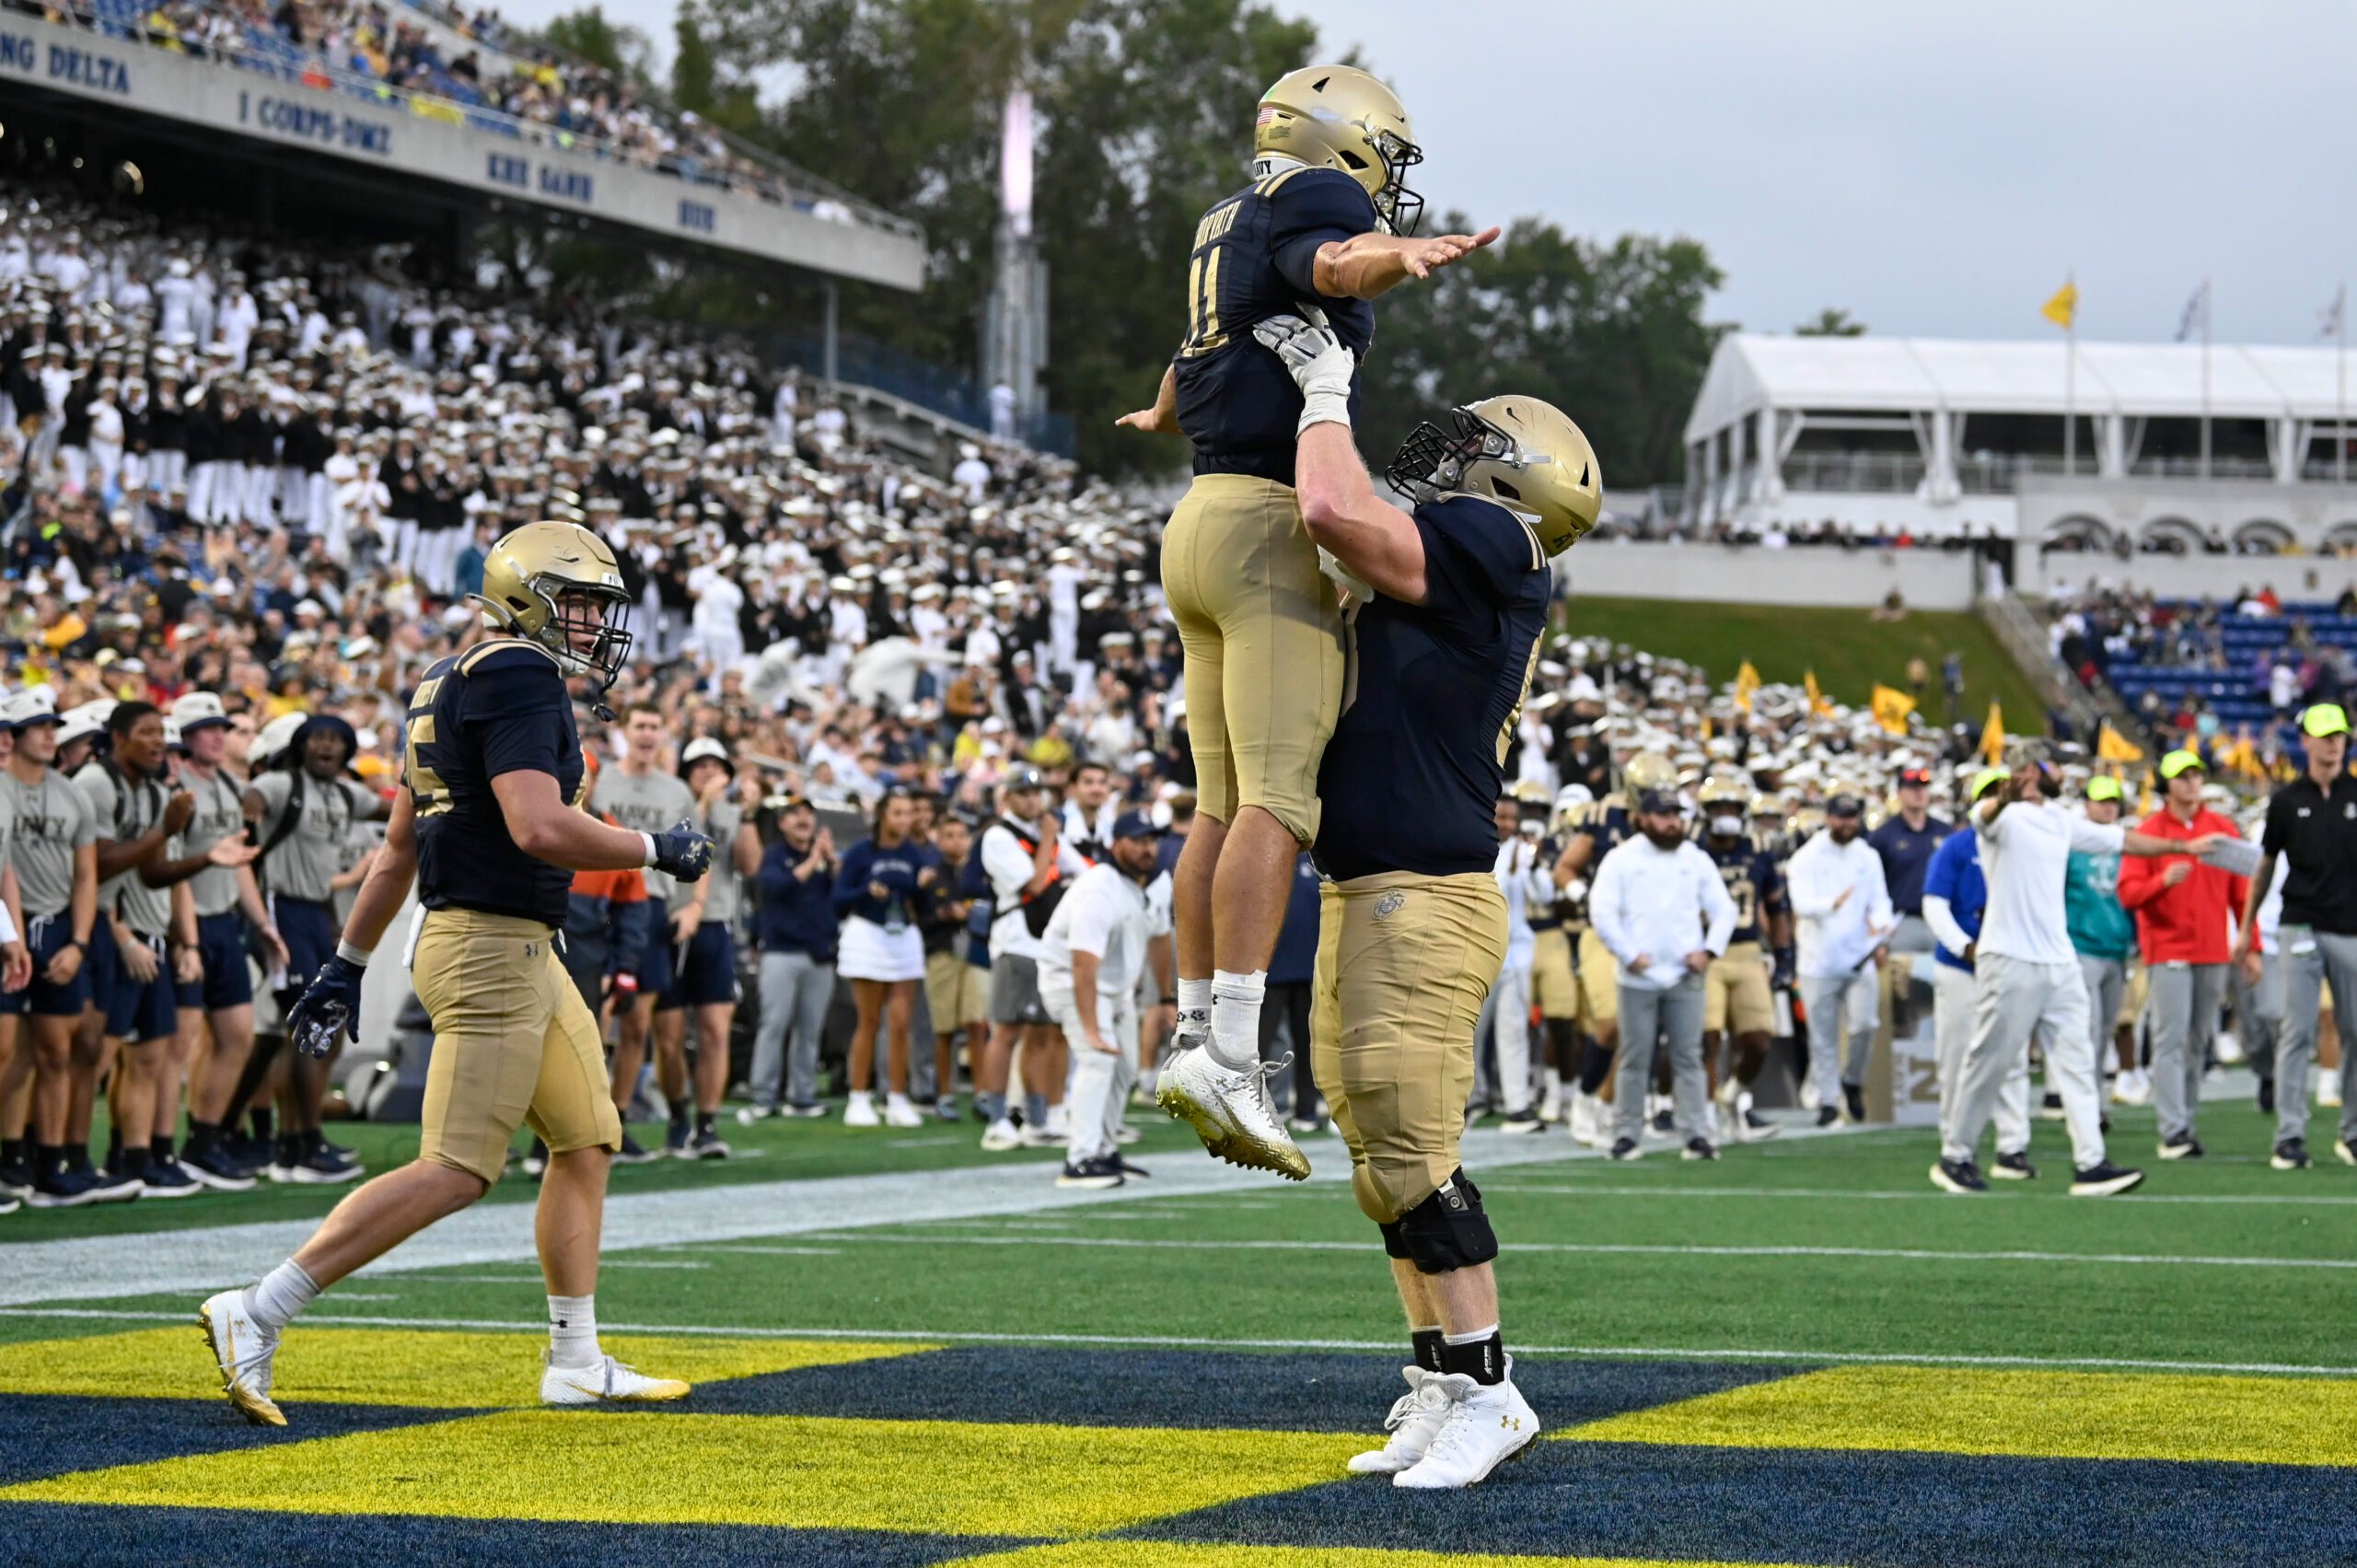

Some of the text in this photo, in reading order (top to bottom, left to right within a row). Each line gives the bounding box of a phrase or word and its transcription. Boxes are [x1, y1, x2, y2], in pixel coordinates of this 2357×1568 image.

[48, 43, 131, 94] DELTA
[1253, 160, 1271, 176] AVY
[1181, 245, 1229, 357] 11
